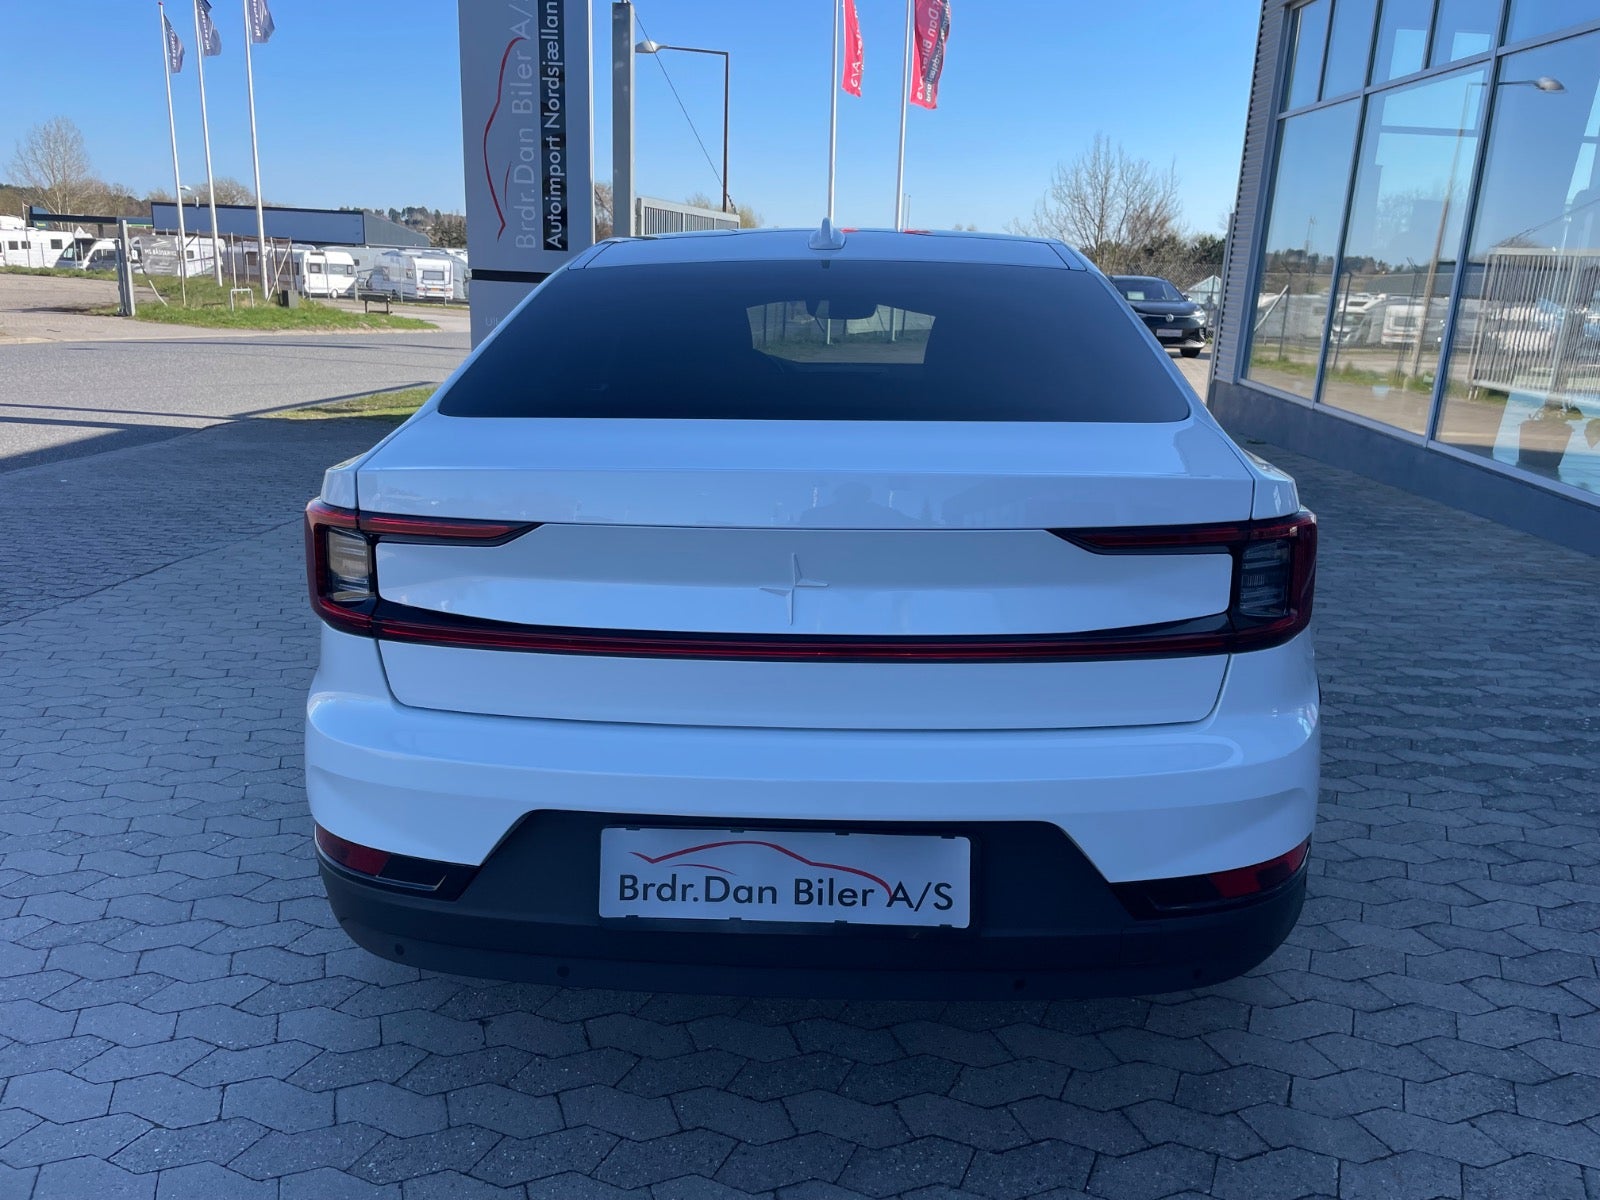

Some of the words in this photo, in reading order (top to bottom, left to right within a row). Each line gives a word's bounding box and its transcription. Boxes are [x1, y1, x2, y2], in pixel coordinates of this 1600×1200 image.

[508, 0, 534, 40] A/
[540, 1, 564, 128] Nordsjællan
[509, 50, 533, 114] Biler
[513, 127, 536, 249] Brdr.Dan
[545, 135, 565, 249] Autoimport
[618, 873, 778, 905] Brdr.Dan
[794, 877, 874, 908] Biler
[885, 881, 954, 912] A/S
